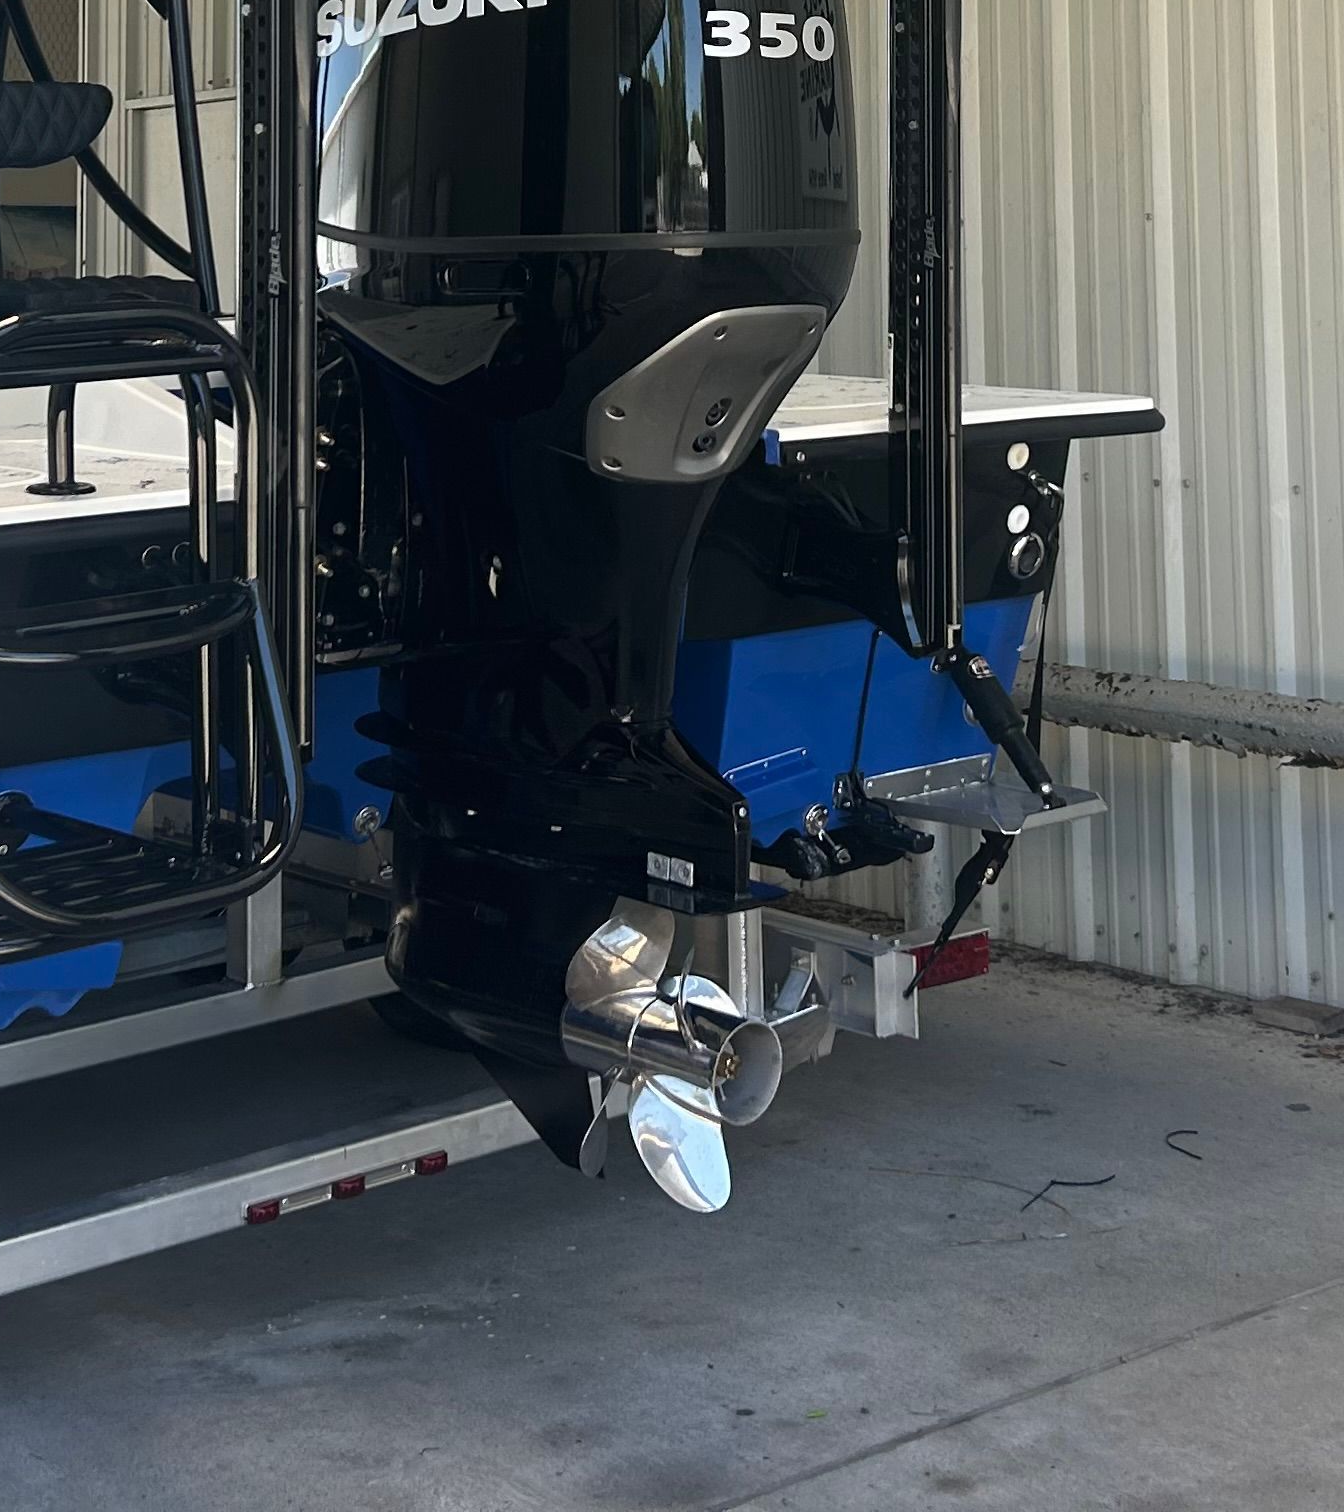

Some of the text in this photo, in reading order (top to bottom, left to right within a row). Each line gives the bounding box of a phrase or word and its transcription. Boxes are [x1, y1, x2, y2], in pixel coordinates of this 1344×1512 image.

[703, 10, 835, 62] 350
[268, 235, 287, 295] Blade
[923, 218, 941, 268] Blade
